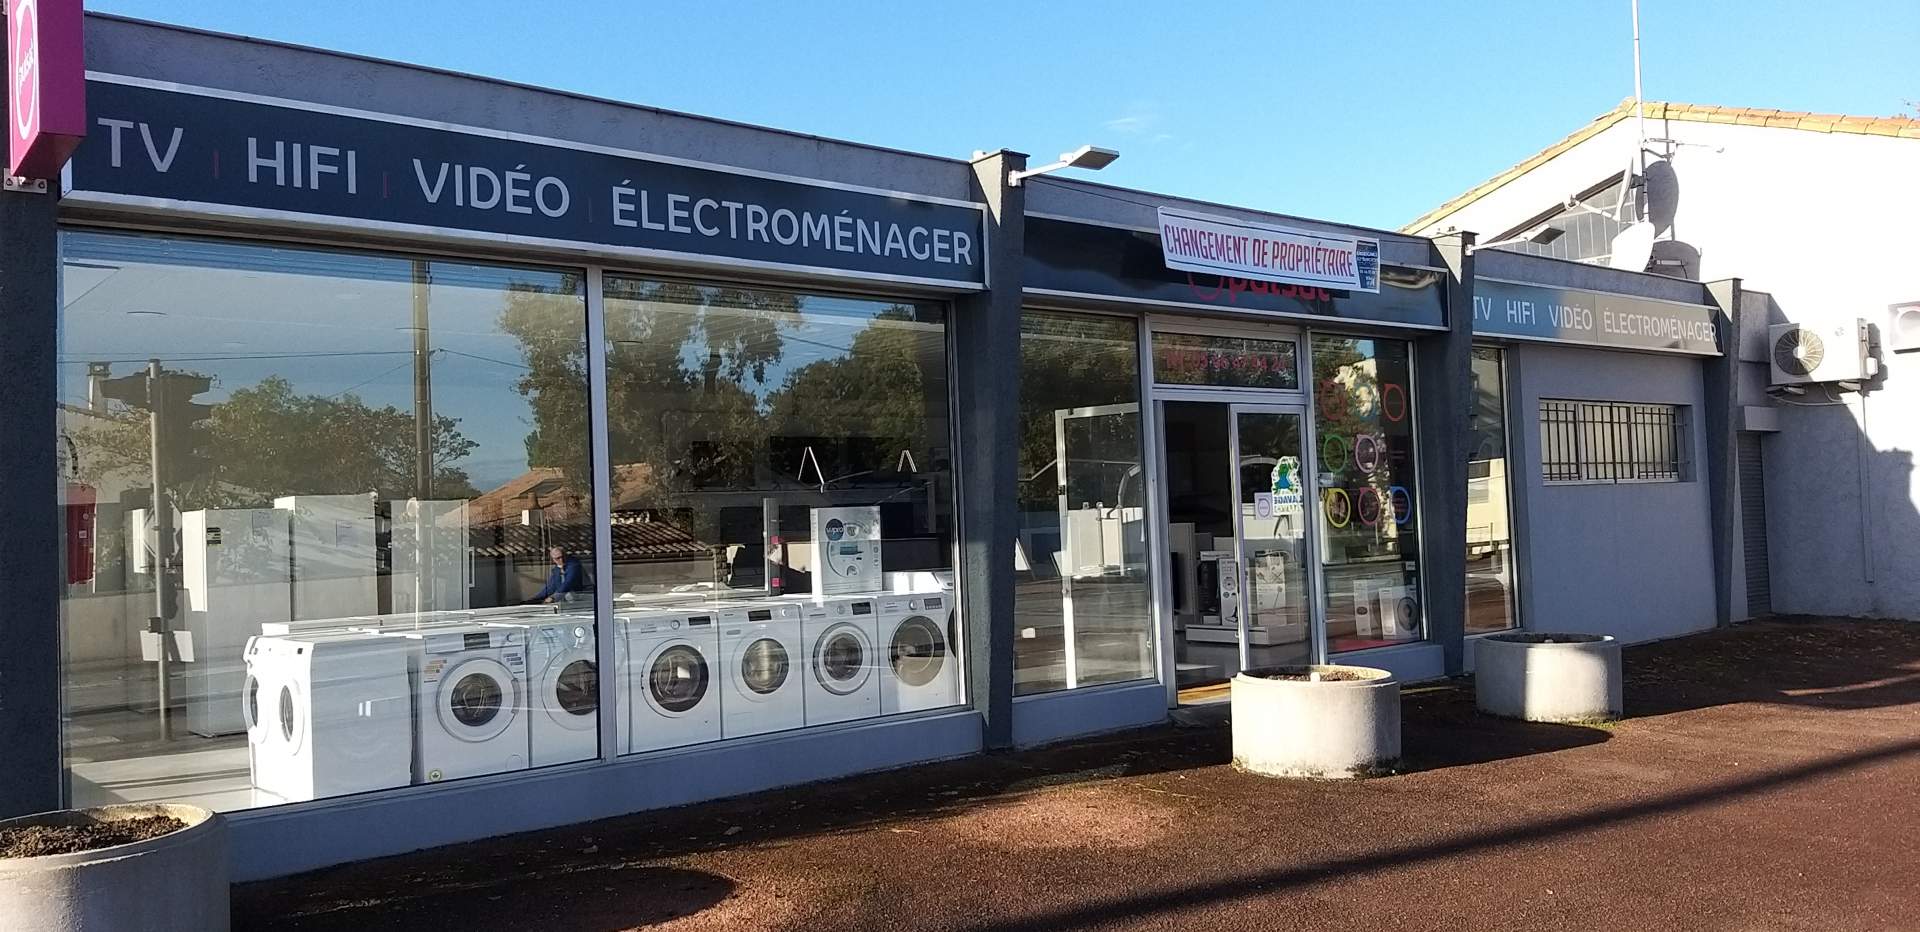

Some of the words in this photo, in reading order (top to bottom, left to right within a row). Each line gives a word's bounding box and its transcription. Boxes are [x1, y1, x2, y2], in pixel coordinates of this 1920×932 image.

[97, 117, 184, 173] TV
[247, 137, 357, 194] HIFI
[412, 158, 570, 218] VIDÉO
[612, 179, 973, 265] ÉLECTROMÉNAGER
[1164, 224, 1249, 265] CHANGEMENT
[1252, 238, 1269, 268] DE
[1271, 241, 1355, 277] PROPRIÉTAIRE
[1473, 295, 1492, 321] TV
[1506, 299, 1536, 325] HIFI
[1548, 304, 1593, 330] VIDÉO
[1603, 307, 1718, 343] ÉLECTROMÉNAGER
